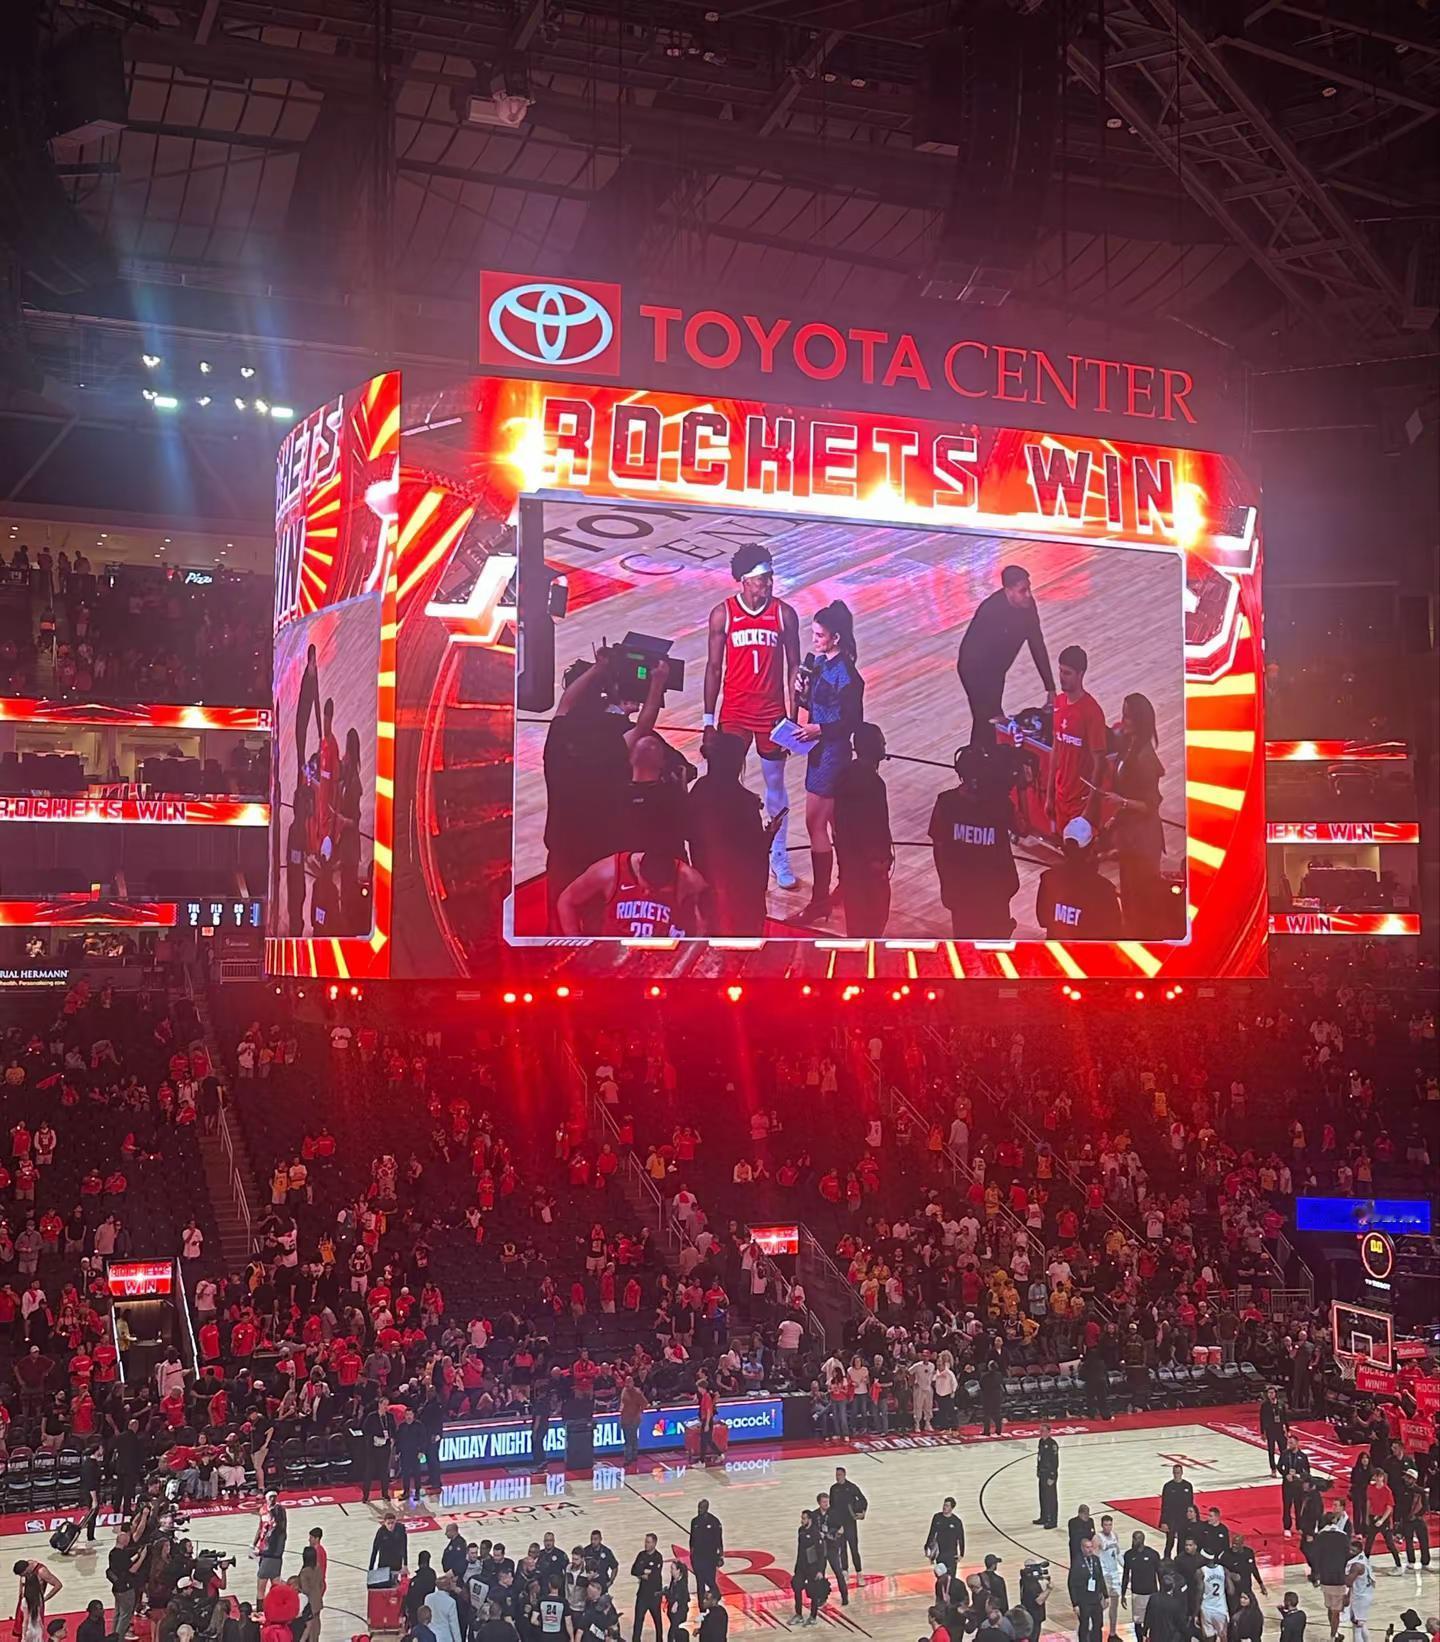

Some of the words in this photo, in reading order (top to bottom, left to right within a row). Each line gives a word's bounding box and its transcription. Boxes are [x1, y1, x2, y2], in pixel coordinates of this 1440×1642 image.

[638, 304, 931, 393] TOYOTA
[943, 340, 1197, 425] CENTER
[542, 396, 980, 511] ROCKETS
[1025, 443, 1178, 538] WIN
[731, 628, 778, 648] ROCKETS
[752, 649, 759, 674] 1
[136, 801, 188, 822] WIN
[953, 823, 996, 846] MEDIA
[1328, 823, 1374, 842] WIN
[616, 900, 671, 924] ROCKETS
[1286, 914, 1331, 934] WIN
[21, 970, 67, 978] HERMANN
[125, 1280, 157, 1295] WIN
[490, 1430, 533, 1457] NIGHT
[440, 1502, 580, 1521] TOYOTA
[1212, 1582, 1220, 1597] 2
